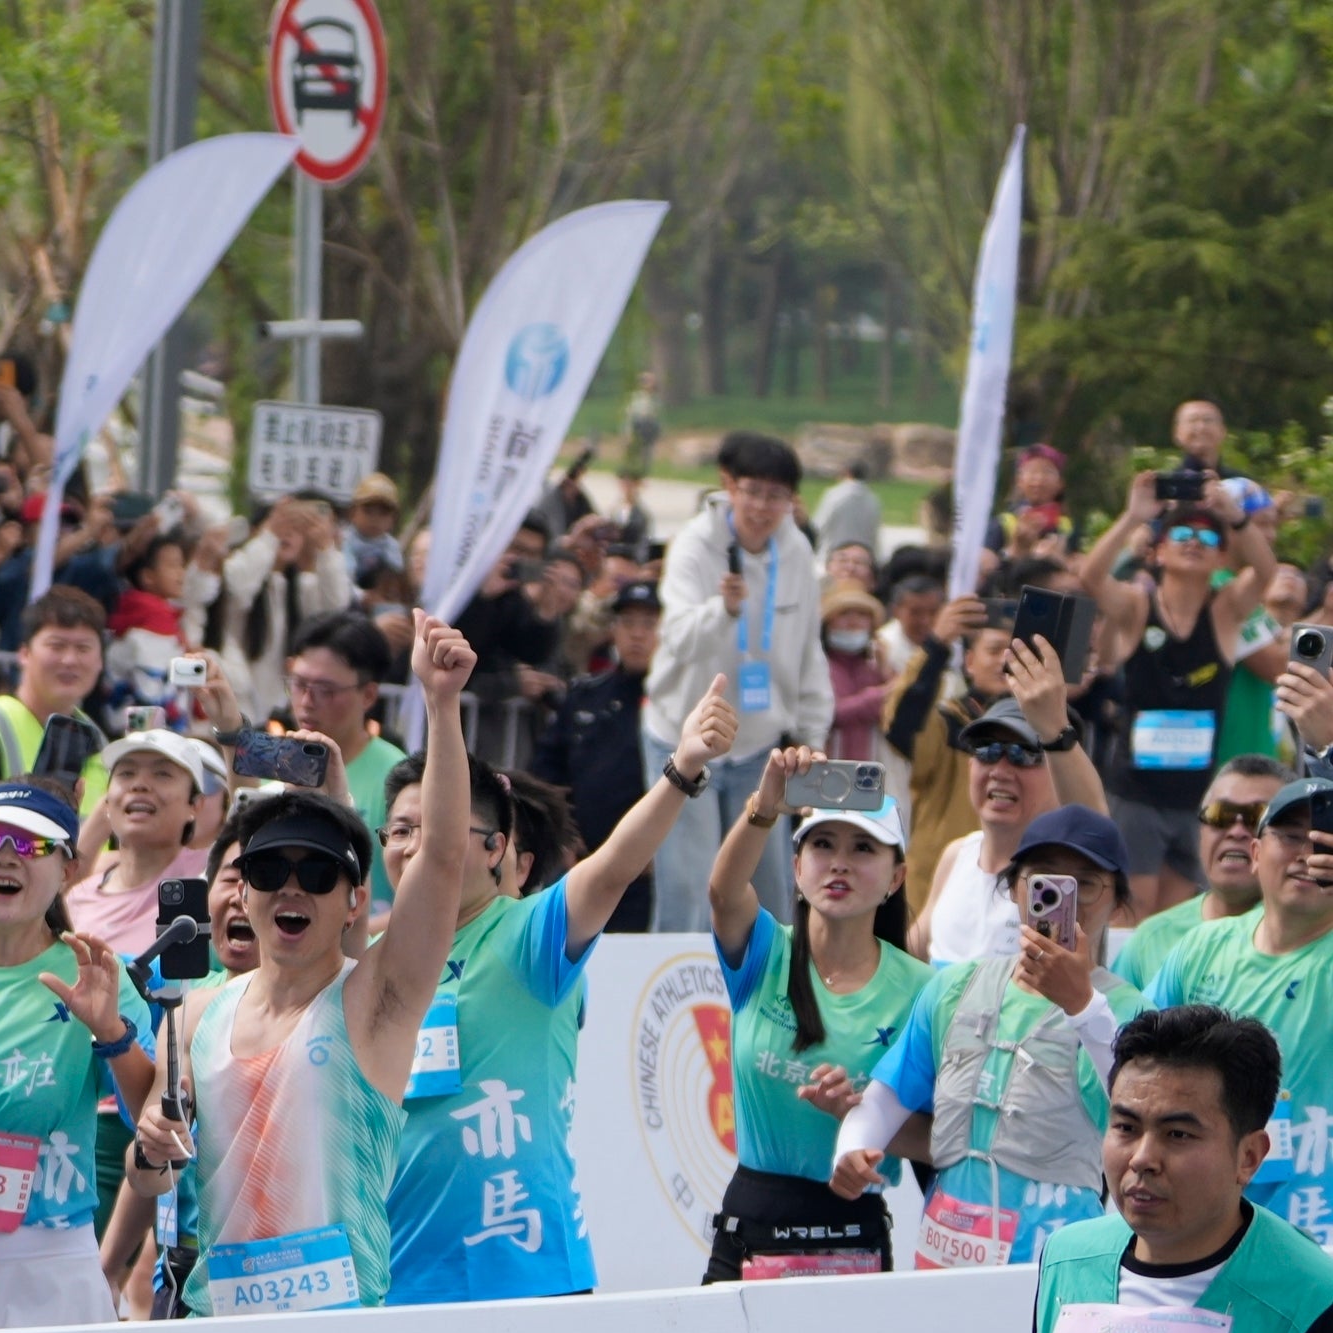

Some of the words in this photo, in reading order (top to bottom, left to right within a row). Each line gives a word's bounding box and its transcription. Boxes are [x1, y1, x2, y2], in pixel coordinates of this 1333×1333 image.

[636, 1020, 664, 1131] CHINESE
[925, 1225, 987, 1264] B07500
[234, 1271, 332, 1307] A03243
